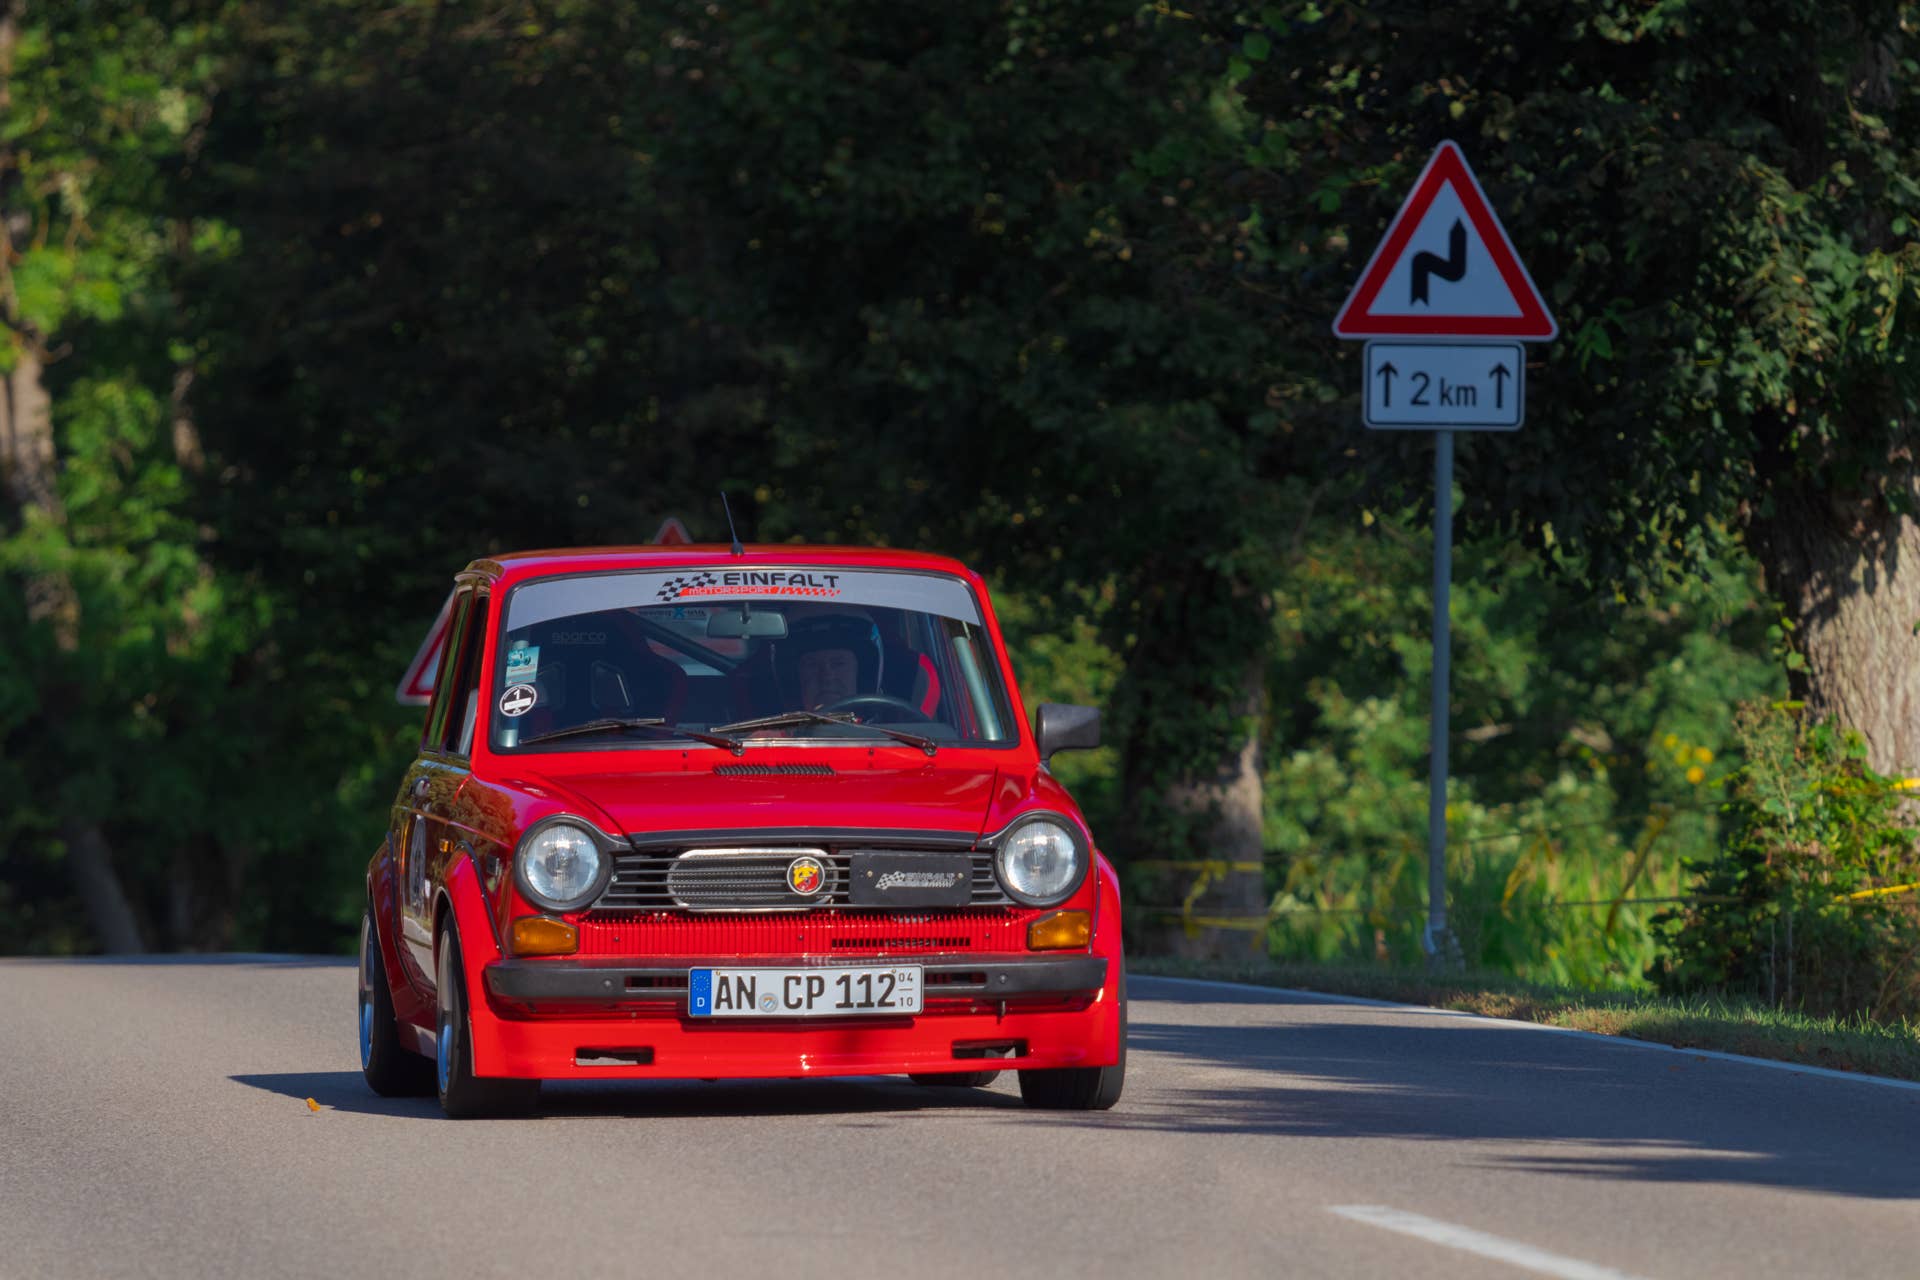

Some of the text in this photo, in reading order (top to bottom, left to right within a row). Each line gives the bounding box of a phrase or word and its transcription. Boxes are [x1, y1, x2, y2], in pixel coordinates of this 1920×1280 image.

[1410, 371, 1477, 407] 2 km
[723, 572, 839, 588] EINFALT
[688, 586, 771, 596] MOTORSPORT
[513, 689, 520, 700] 1
[898, 973, 913, 983] 04
[714, 973, 896, 1010] AN CP 112
[696, 997, 705, 1007] D
[899, 997, 913, 1007] 10
